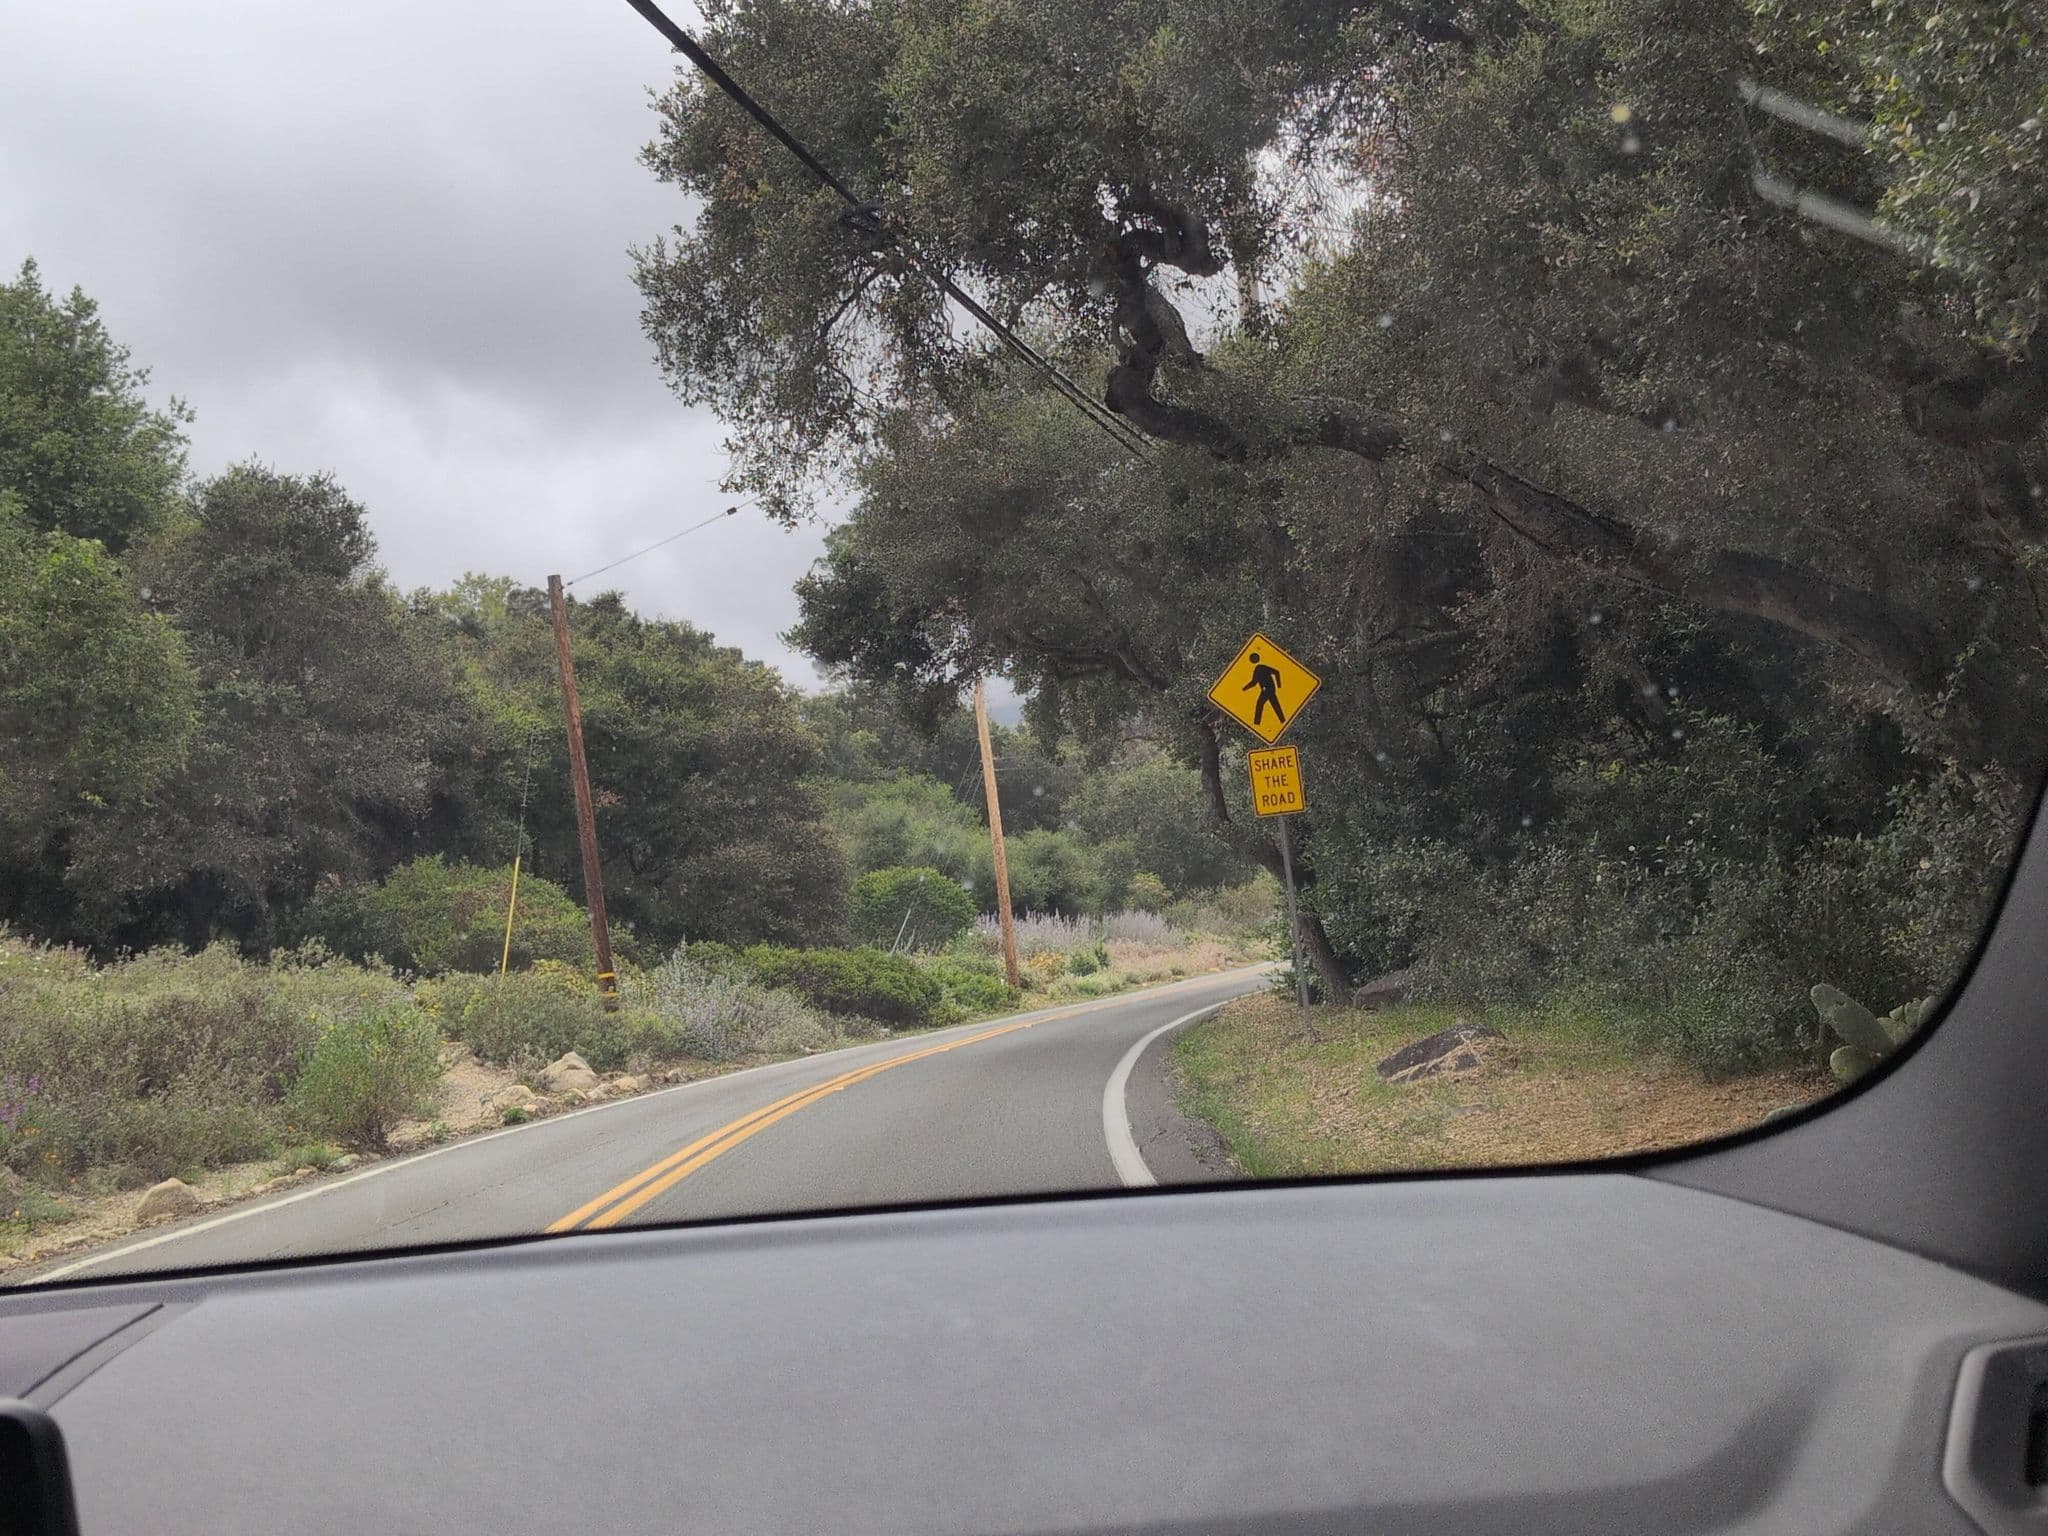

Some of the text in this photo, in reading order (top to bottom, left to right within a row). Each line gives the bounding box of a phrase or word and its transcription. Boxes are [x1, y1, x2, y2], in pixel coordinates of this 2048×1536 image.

[1254, 755, 1294, 772] SHARE
[1264, 774, 1288, 788] THE
[1262, 791, 1295, 807] ROAD
